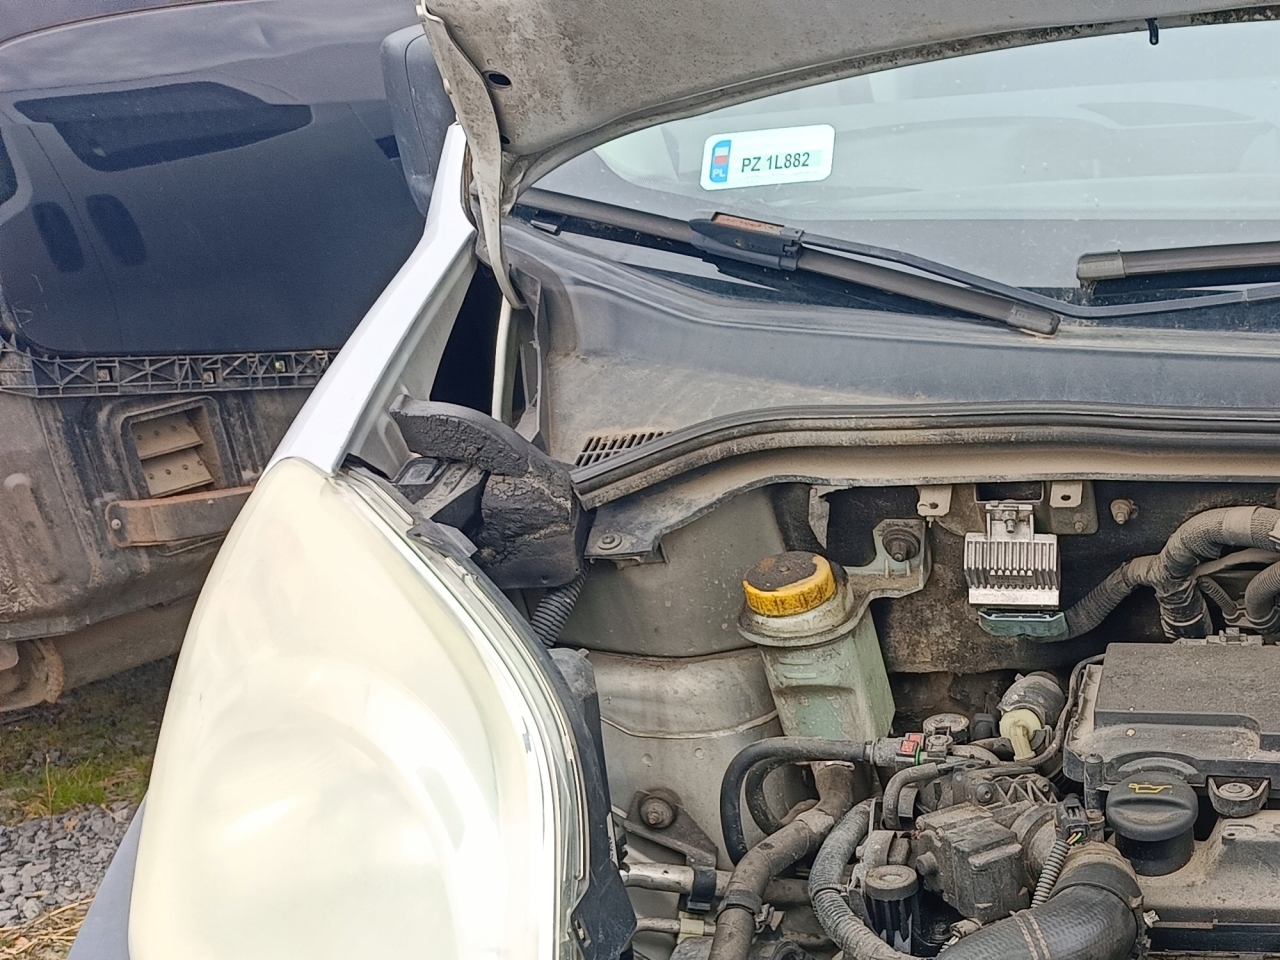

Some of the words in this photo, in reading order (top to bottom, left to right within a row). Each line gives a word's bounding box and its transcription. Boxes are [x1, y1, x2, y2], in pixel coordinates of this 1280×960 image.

[741, 156, 761, 173] PZ
[766, 152, 810, 171] 1L882
[711, 169, 726, 178] PL
